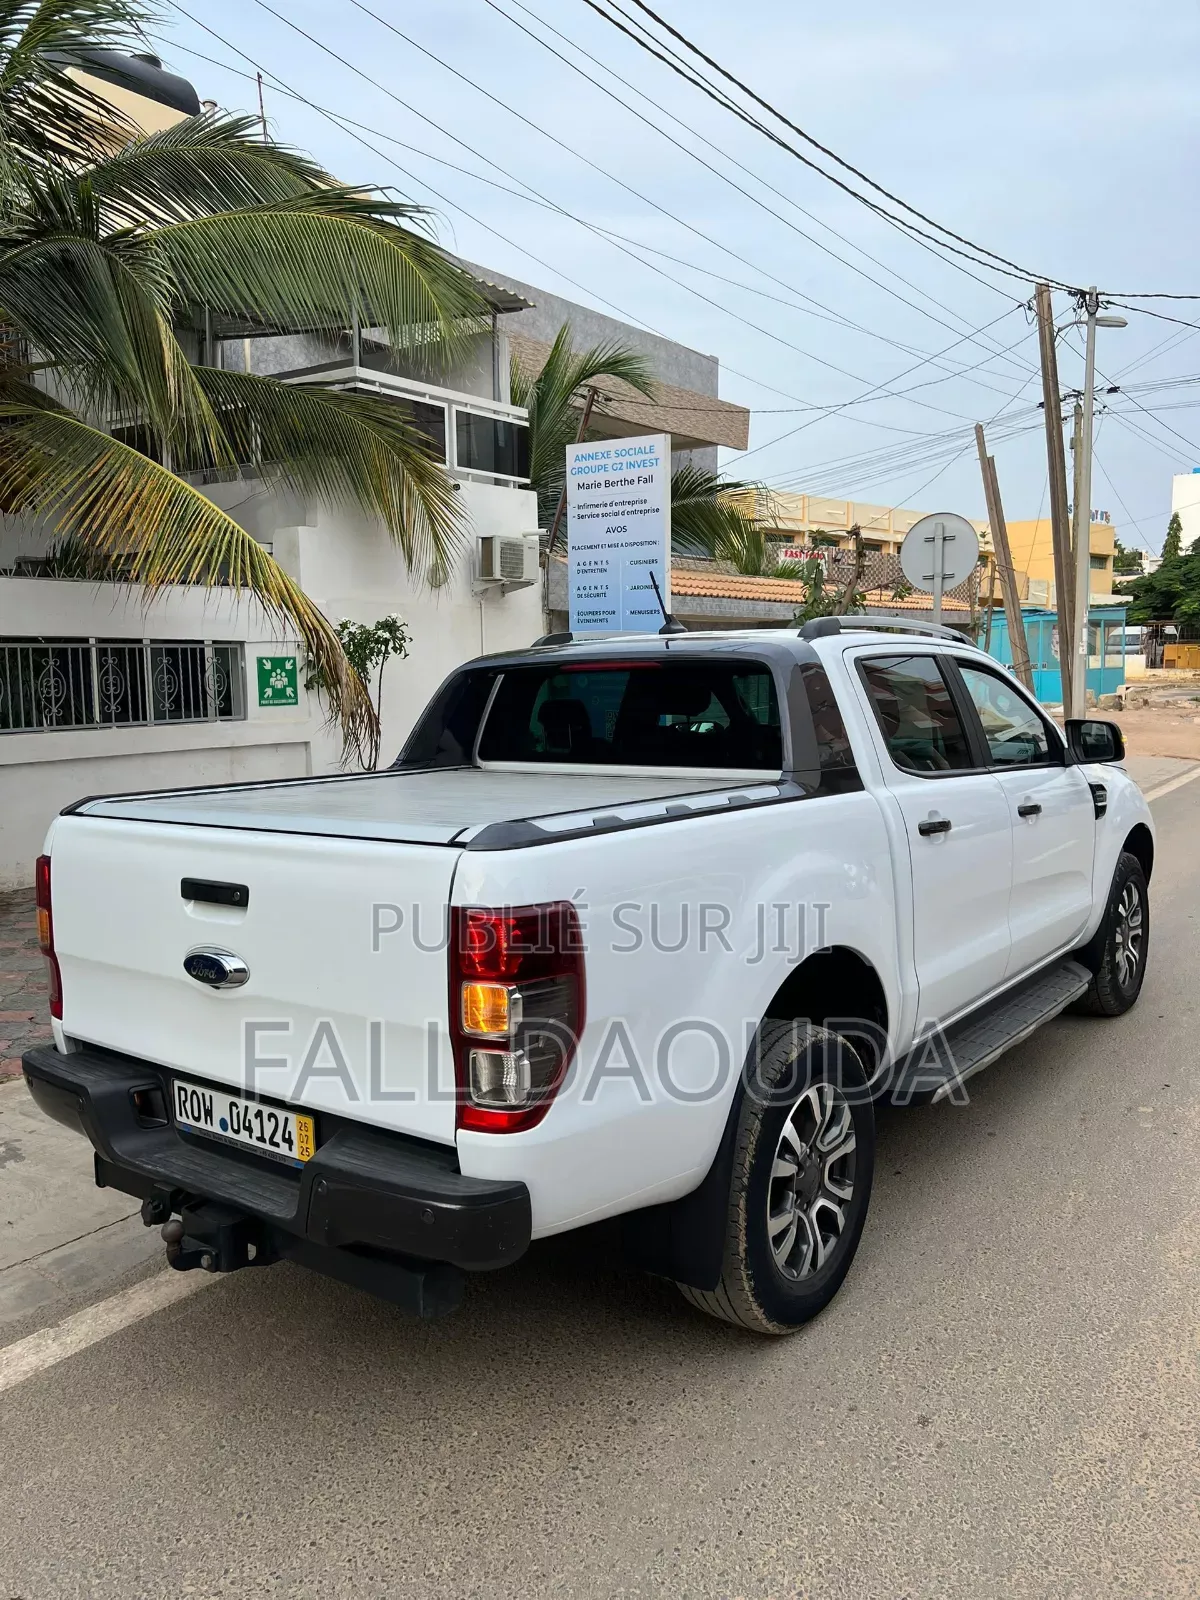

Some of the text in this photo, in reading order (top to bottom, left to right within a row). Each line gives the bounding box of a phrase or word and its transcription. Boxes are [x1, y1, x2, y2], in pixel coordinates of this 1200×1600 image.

[574, 445, 655, 463] ANNEXE SOCIALE
[570, 458, 660, 476] GROUPE G2 INVEST
[577, 475, 654, 491] Marie Berthe Fall
[577, 501, 608, 510] Infirmerie
[608, 498, 648, 508] d'entreprise
[577, 511, 600, 520] Service
[601, 509, 620, 518] social
[621, 506, 660, 516] d'entreprise
[605, 525, 628, 534] AVOS
[571, 543, 600, 551] PLACEMENT
[625, 540, 657, 548] DISPOSITION
[190, 960, 217, 979] Ford
[177, 1085, 294, 1152] ROW 04124
[298, 1120, 309, 1133] 26
[299, 1133, 309, 1145] 07
[300, 1145, 311, 1157] 25
